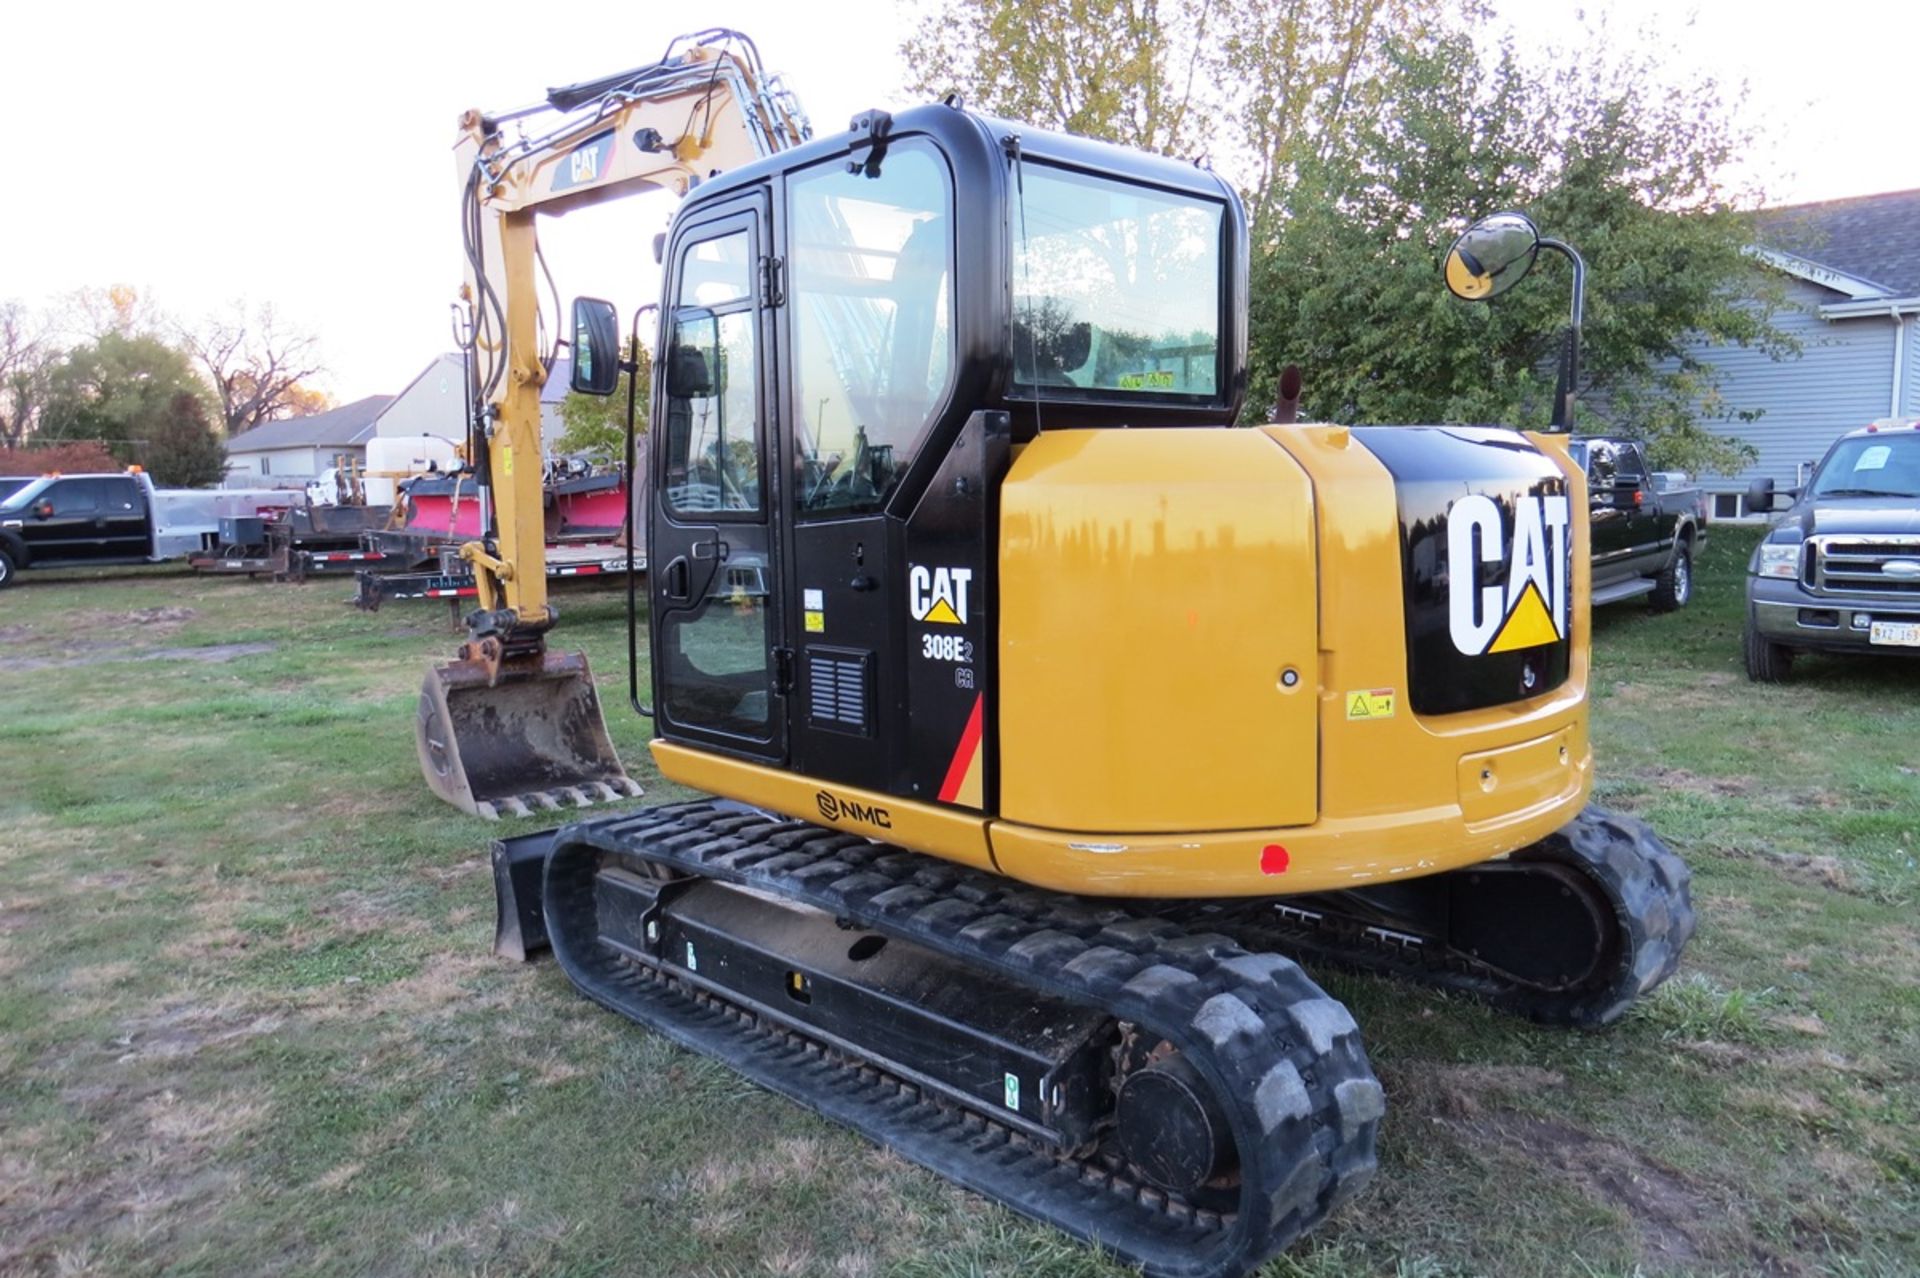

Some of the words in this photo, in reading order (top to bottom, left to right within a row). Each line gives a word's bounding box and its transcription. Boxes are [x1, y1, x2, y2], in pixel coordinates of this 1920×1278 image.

[571, 146, 599, 183] CAT
[910, 565, 971, 624] CAT
[1448, 495, 1569, 656] CAT
[840, 799, 892, 829] NMC
